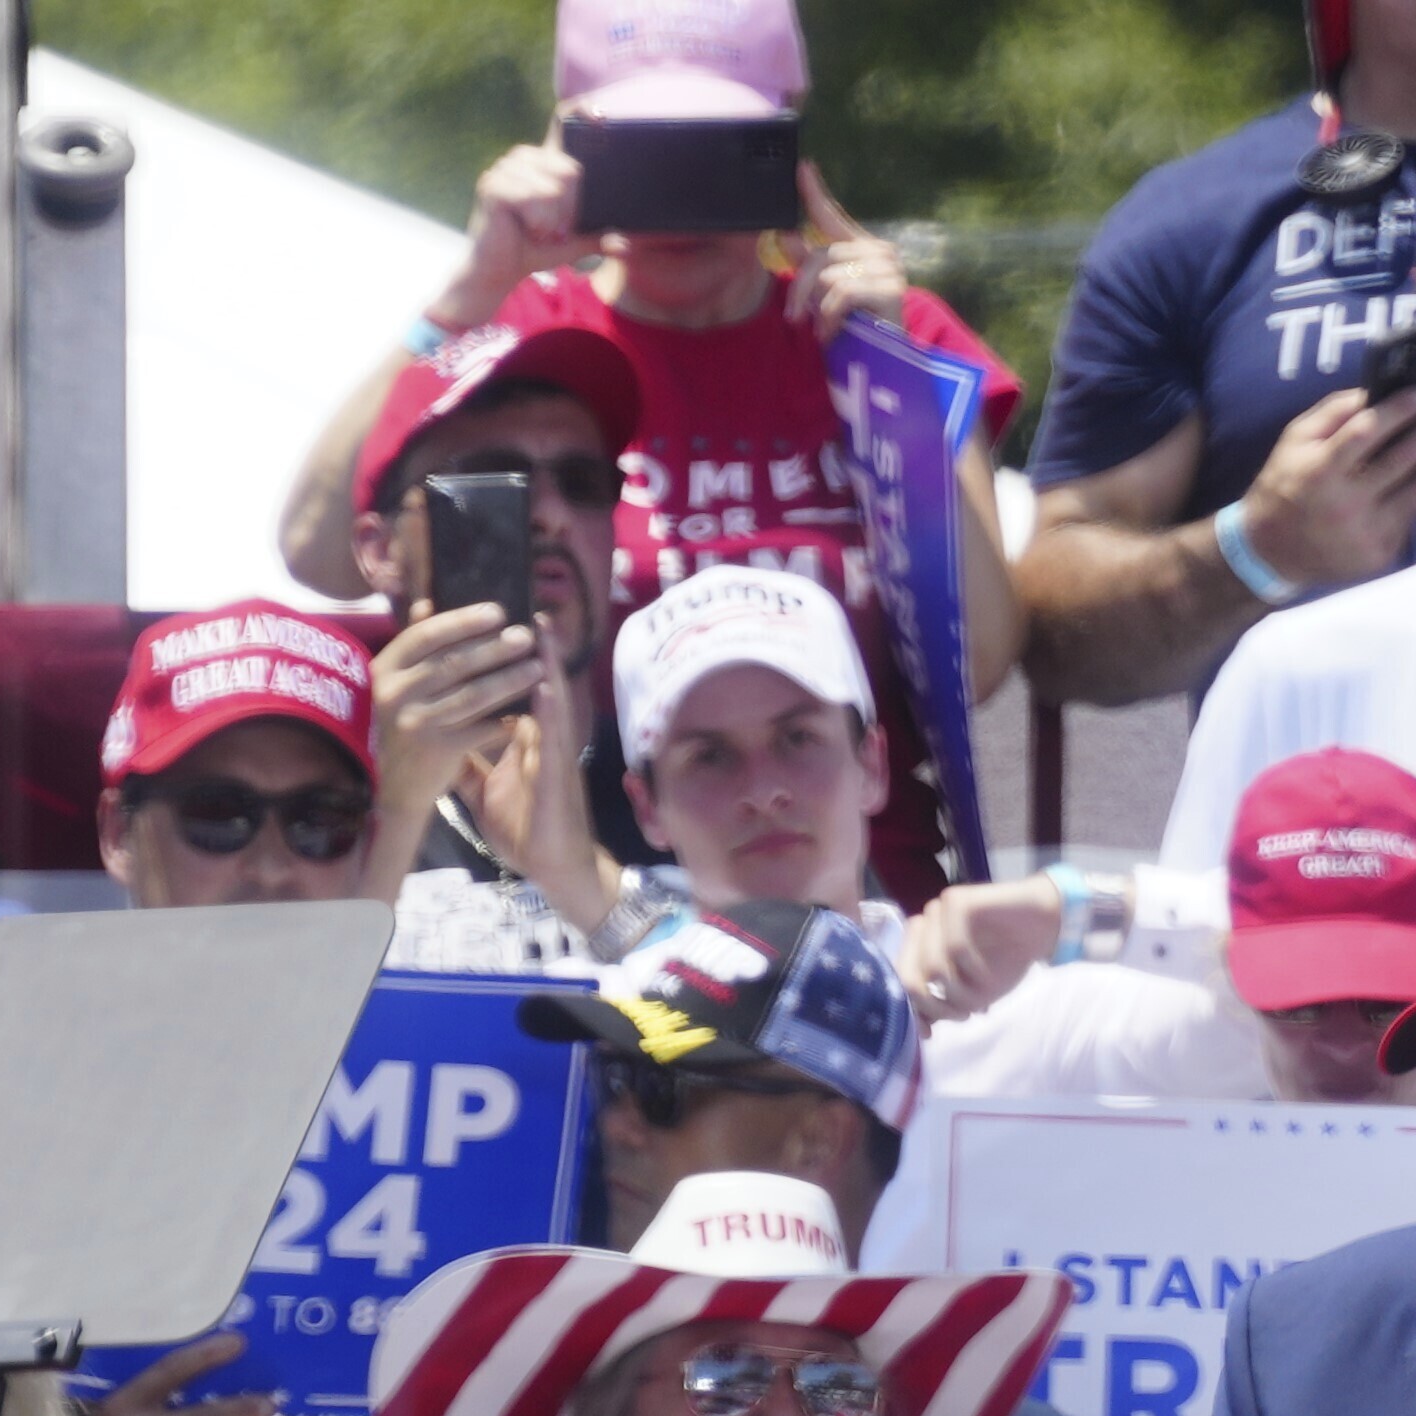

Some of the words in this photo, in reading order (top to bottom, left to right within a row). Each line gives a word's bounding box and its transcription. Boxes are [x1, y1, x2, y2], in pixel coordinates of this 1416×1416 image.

[647, 505, 760, 544] FOR
[149, 616, 242, 677] MAKE
[242, 612, 369, 689] AMERICA
[170, 655, 272, 714] GREAT
[268, 659, 355, 722] AGAIN
[267, 1295, 337, 1337] TO
